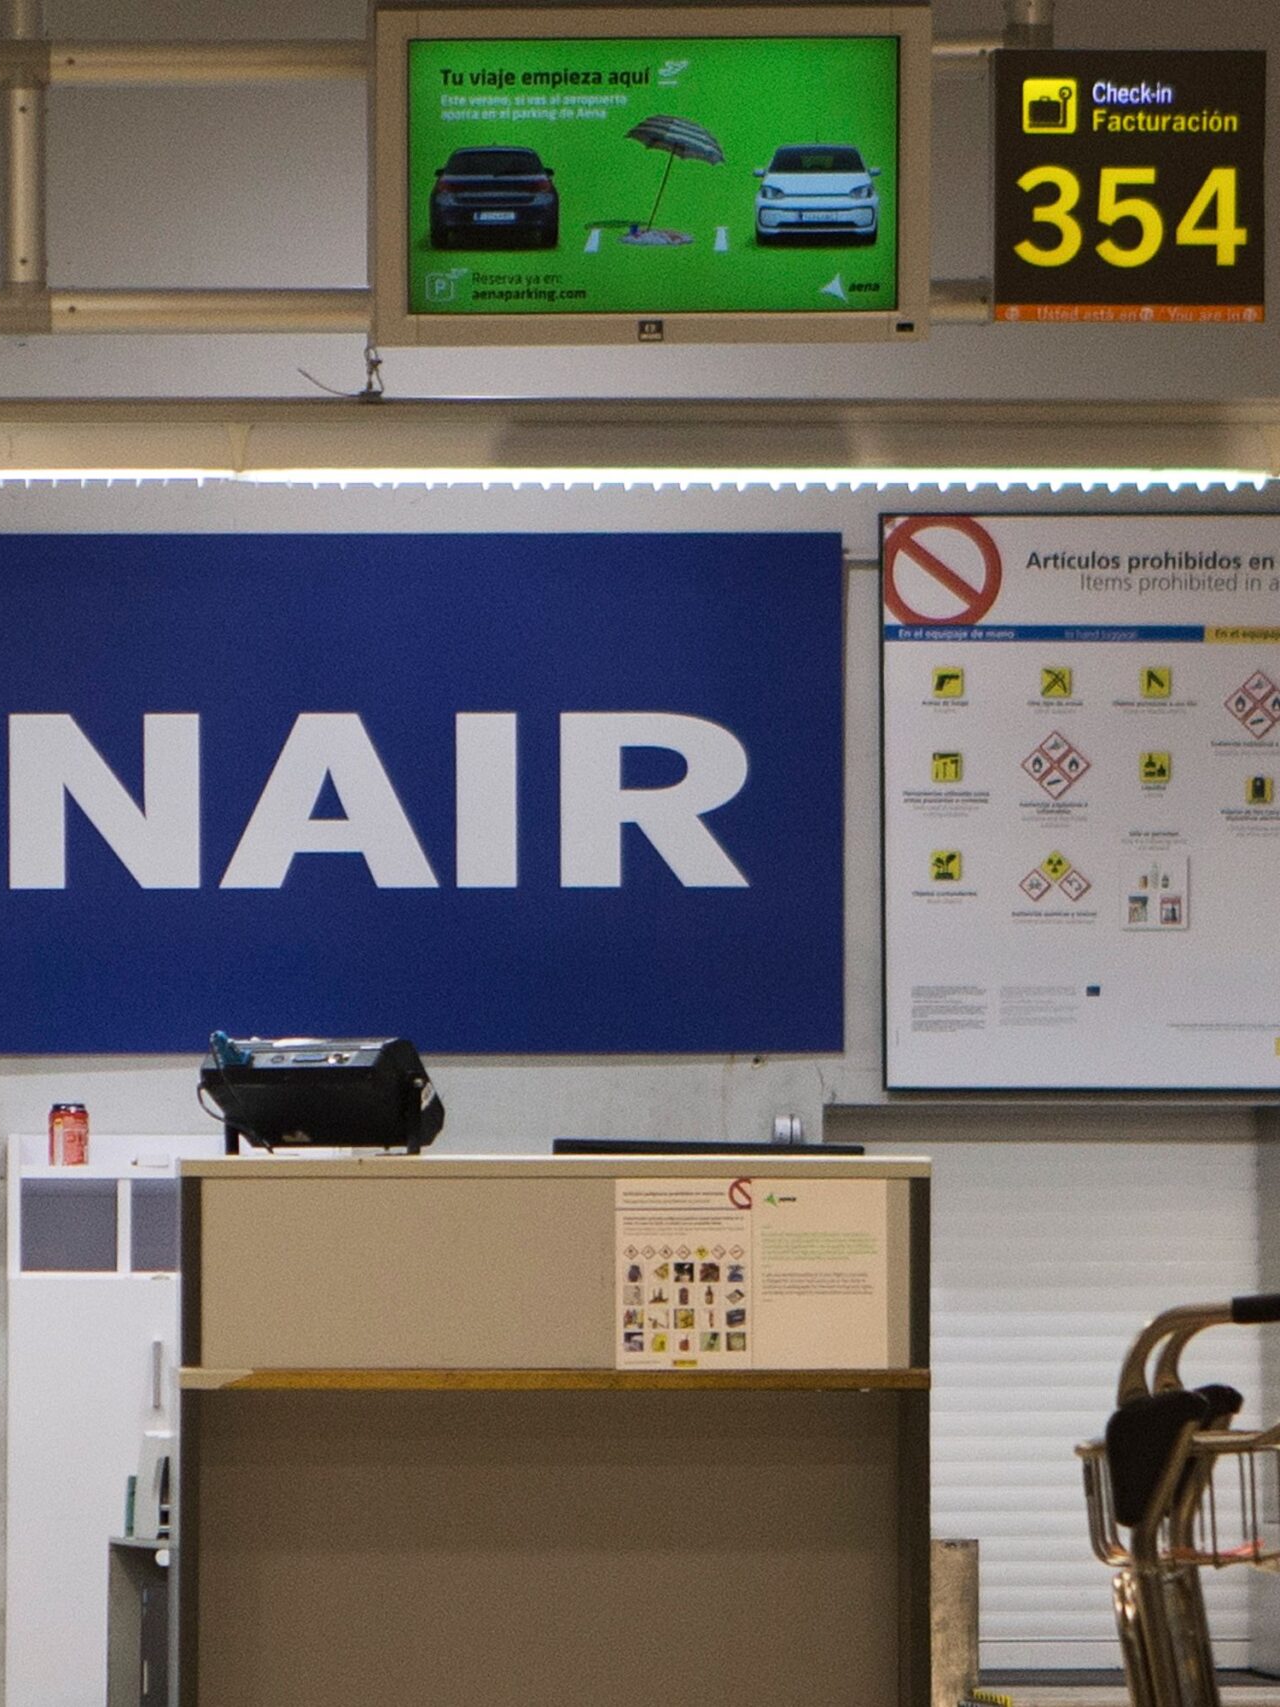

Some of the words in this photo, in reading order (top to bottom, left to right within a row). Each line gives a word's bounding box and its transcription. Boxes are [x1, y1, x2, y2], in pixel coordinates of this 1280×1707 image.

[440, 68, 464, 86] Tu
[469, 68, 515, 89] viaje
[521, 68, 603, 89] empieza
[608, 67, 650, 88] aquí
[1092, 82, 1172, 104] Check-in
[1092, 110, 1238, 132] Facturación
[1014, 166, 1248, 267] 354
[472, 272, 522, 285] Reserva
[523, 275, 540, 287] ya
[848, 283, 881, 293] aena
[472, 289, 587, 302] aenaparking.com
[1168, 306, 1193, 321] You
[1026, 550, 1120, 570] Artículos
[1127, 551, 1242, 574] prohibidos
[1249, 555, 1275, 570] en
[1080, 573, 1132, 593] Items
[1138, 573, 1238, 596] prohibited
[1245, 573, 1262, 592] in
[898, 628, 912, 639] En
[971, 628, 984, 639] de
